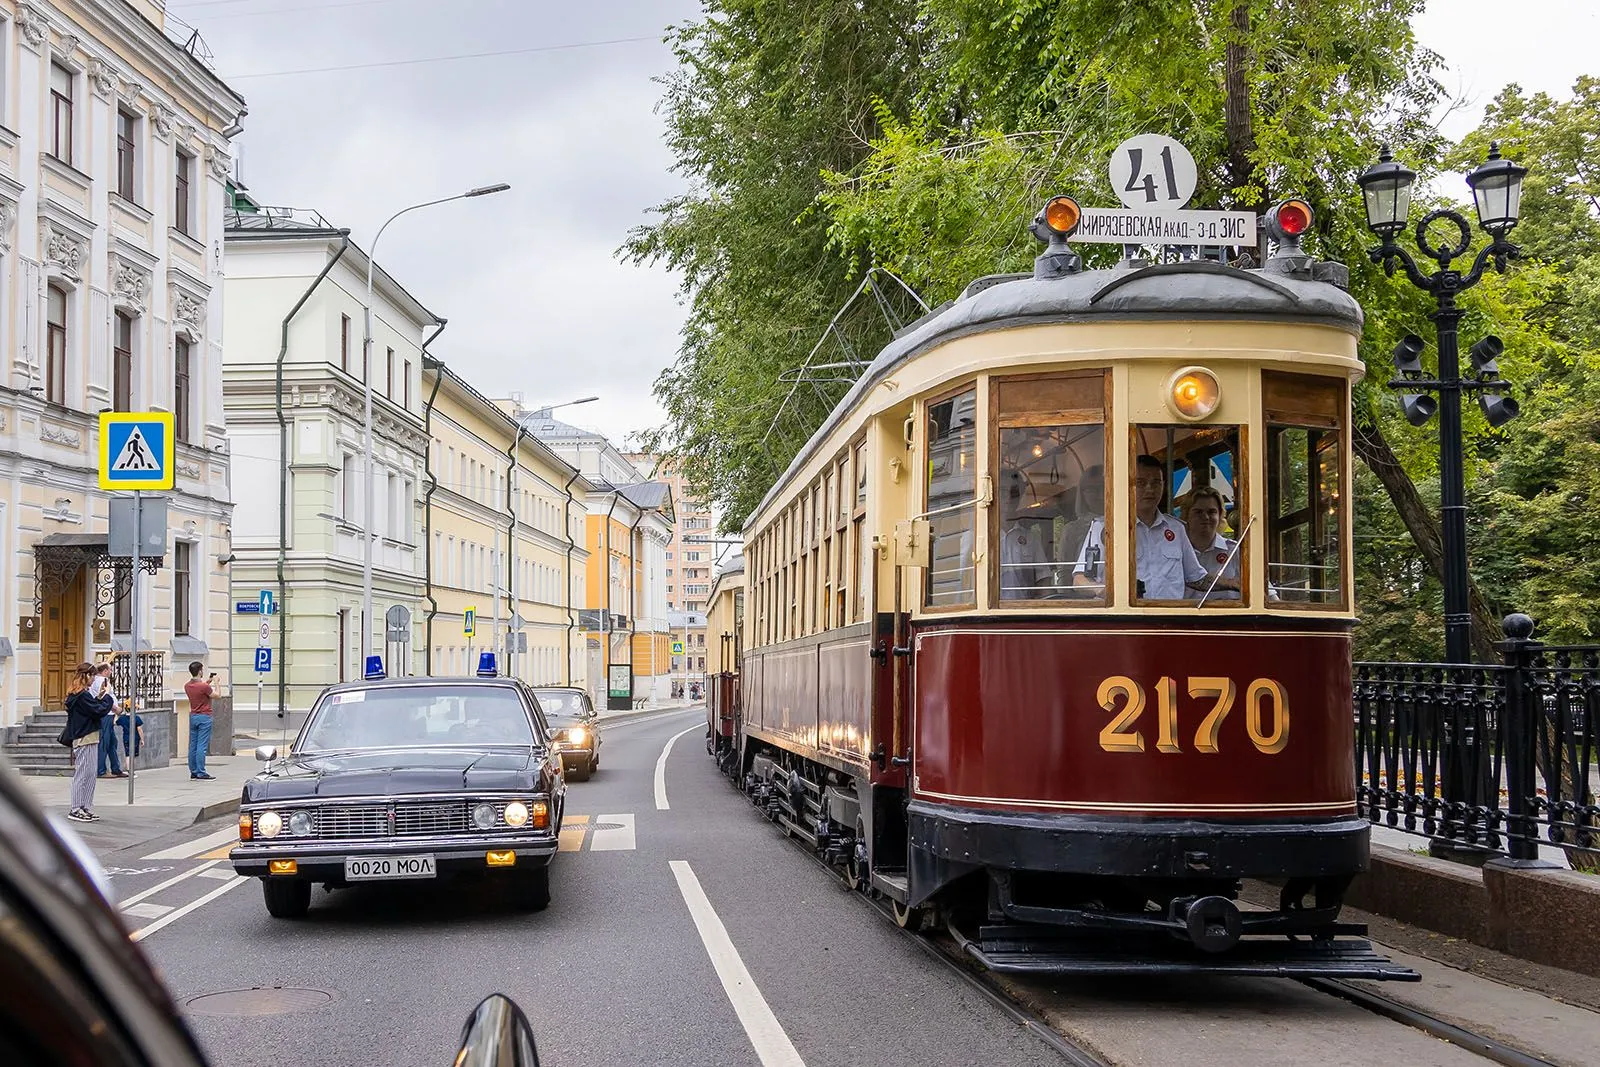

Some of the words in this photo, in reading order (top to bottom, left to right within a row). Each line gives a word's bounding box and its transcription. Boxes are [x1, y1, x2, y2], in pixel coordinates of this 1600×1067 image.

[1125, 146, 1181, 202] 41
[1075, 215, 1162, 237] МИРЯЗЕВСКАЯ
[1220, 217, 1246, 239] ЗИС
[258, 650, 268, 669] P
[1096, 675, 1290, 754] 2170
[397, 859, 431, 874] МОЛ
